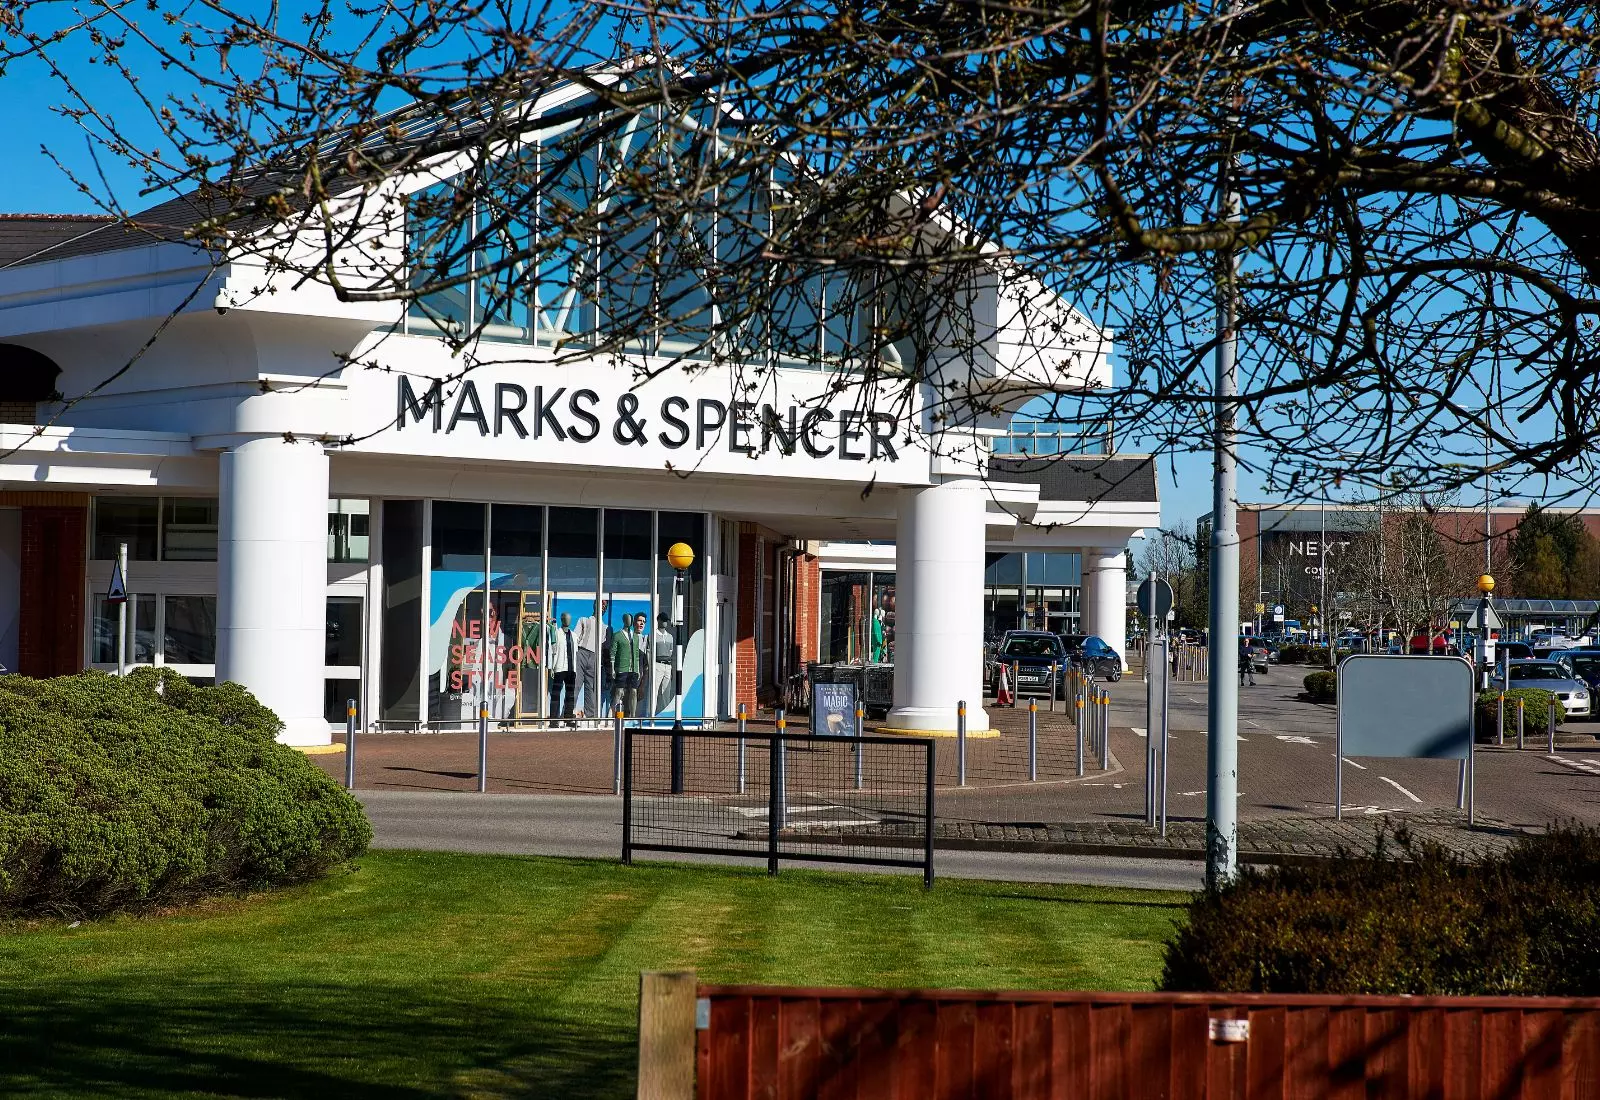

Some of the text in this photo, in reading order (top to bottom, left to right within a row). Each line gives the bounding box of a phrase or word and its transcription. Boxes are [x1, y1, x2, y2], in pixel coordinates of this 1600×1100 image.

[397, 374, 899, 463] MARKS & SPENCER
[1289, 541, 1351, 556] NEXT
[452, 620, 502, 639] NEW
[451, 645, 541, 665] SEASON
[451, 670, 519, 690] STYLE
[823, 695, 848, 708] MAGIC
